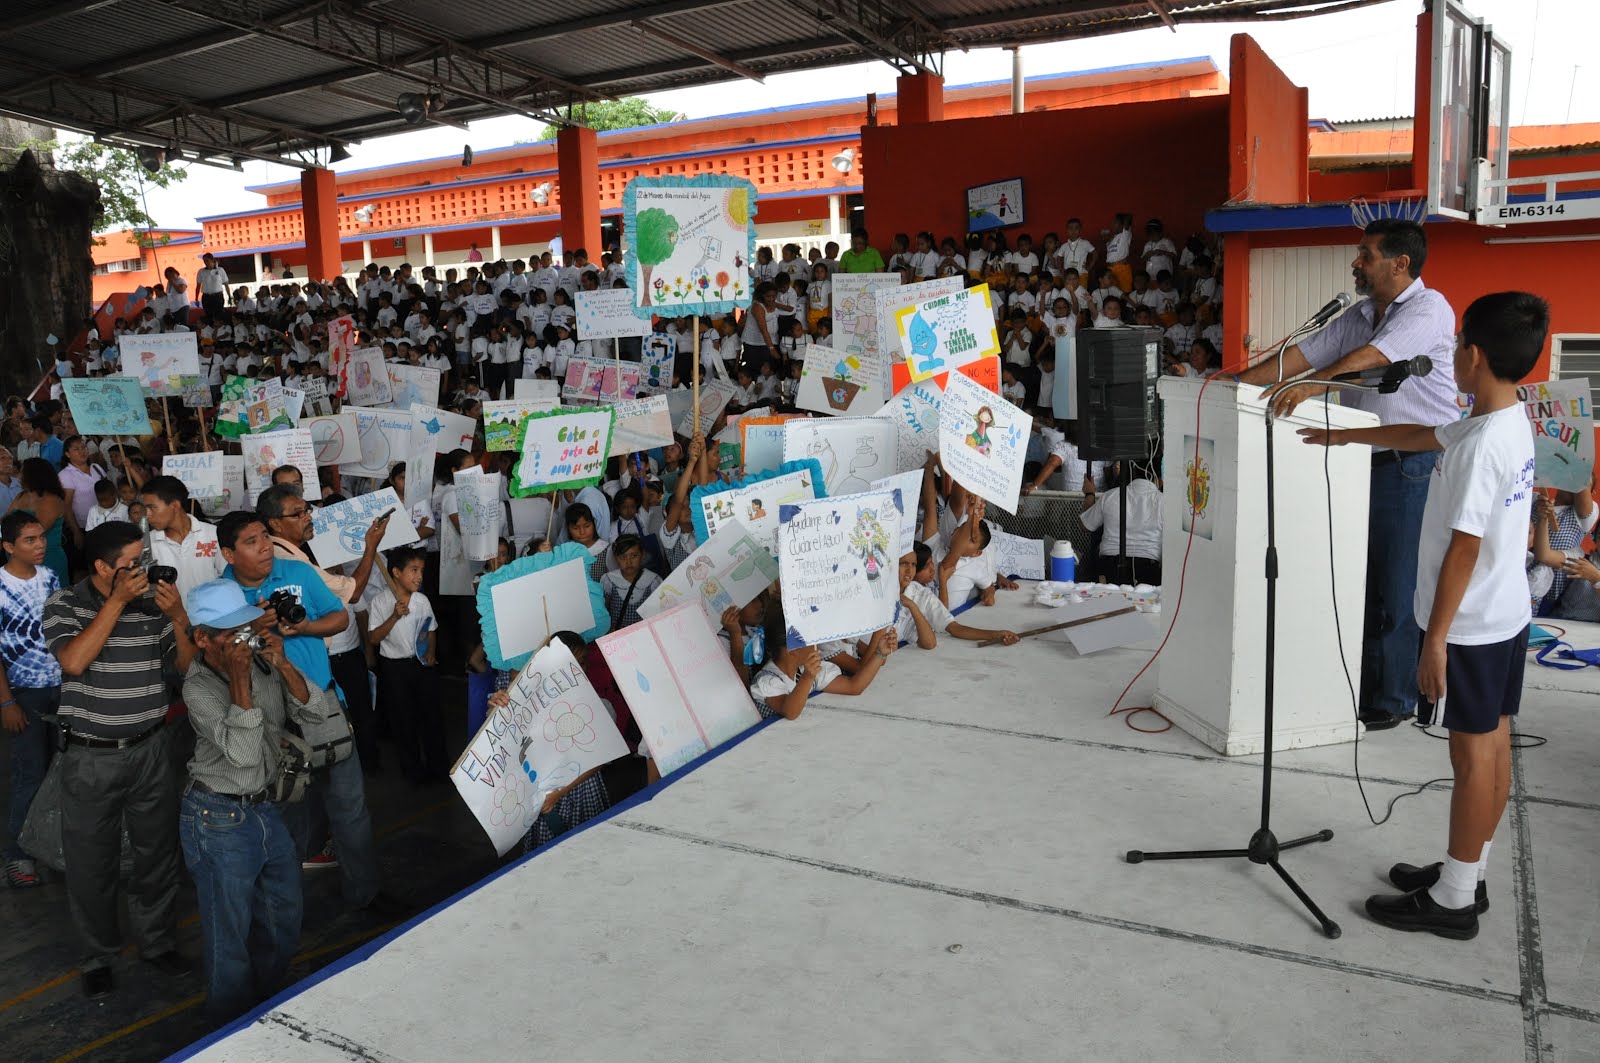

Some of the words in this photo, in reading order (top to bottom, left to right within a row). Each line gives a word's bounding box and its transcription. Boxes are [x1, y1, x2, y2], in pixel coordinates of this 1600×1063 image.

[1498, 204, 1565, 218] EM-6314
[968, 368, 980, 377] NO
[984, 368, 996, 376] ME
[1516, 384, 1551, 402] URA
[1527, 400, 1565, 419] INA
[1570, 397, 1590, 417] EL
[558, 426, 586, 443] Gota
[748, 427, 758, 440] El
[1534, 420, 1581, 452] AGUA
[587, 440, 598, 455] el
[460, 750, 491, 782] EL
[485, 698, 521, 752] AGUA
[516, 663, 542, 699] ES
[480, 745, 511, 788] VIDA
[505, 663, 588, 744] PROTEGELA
